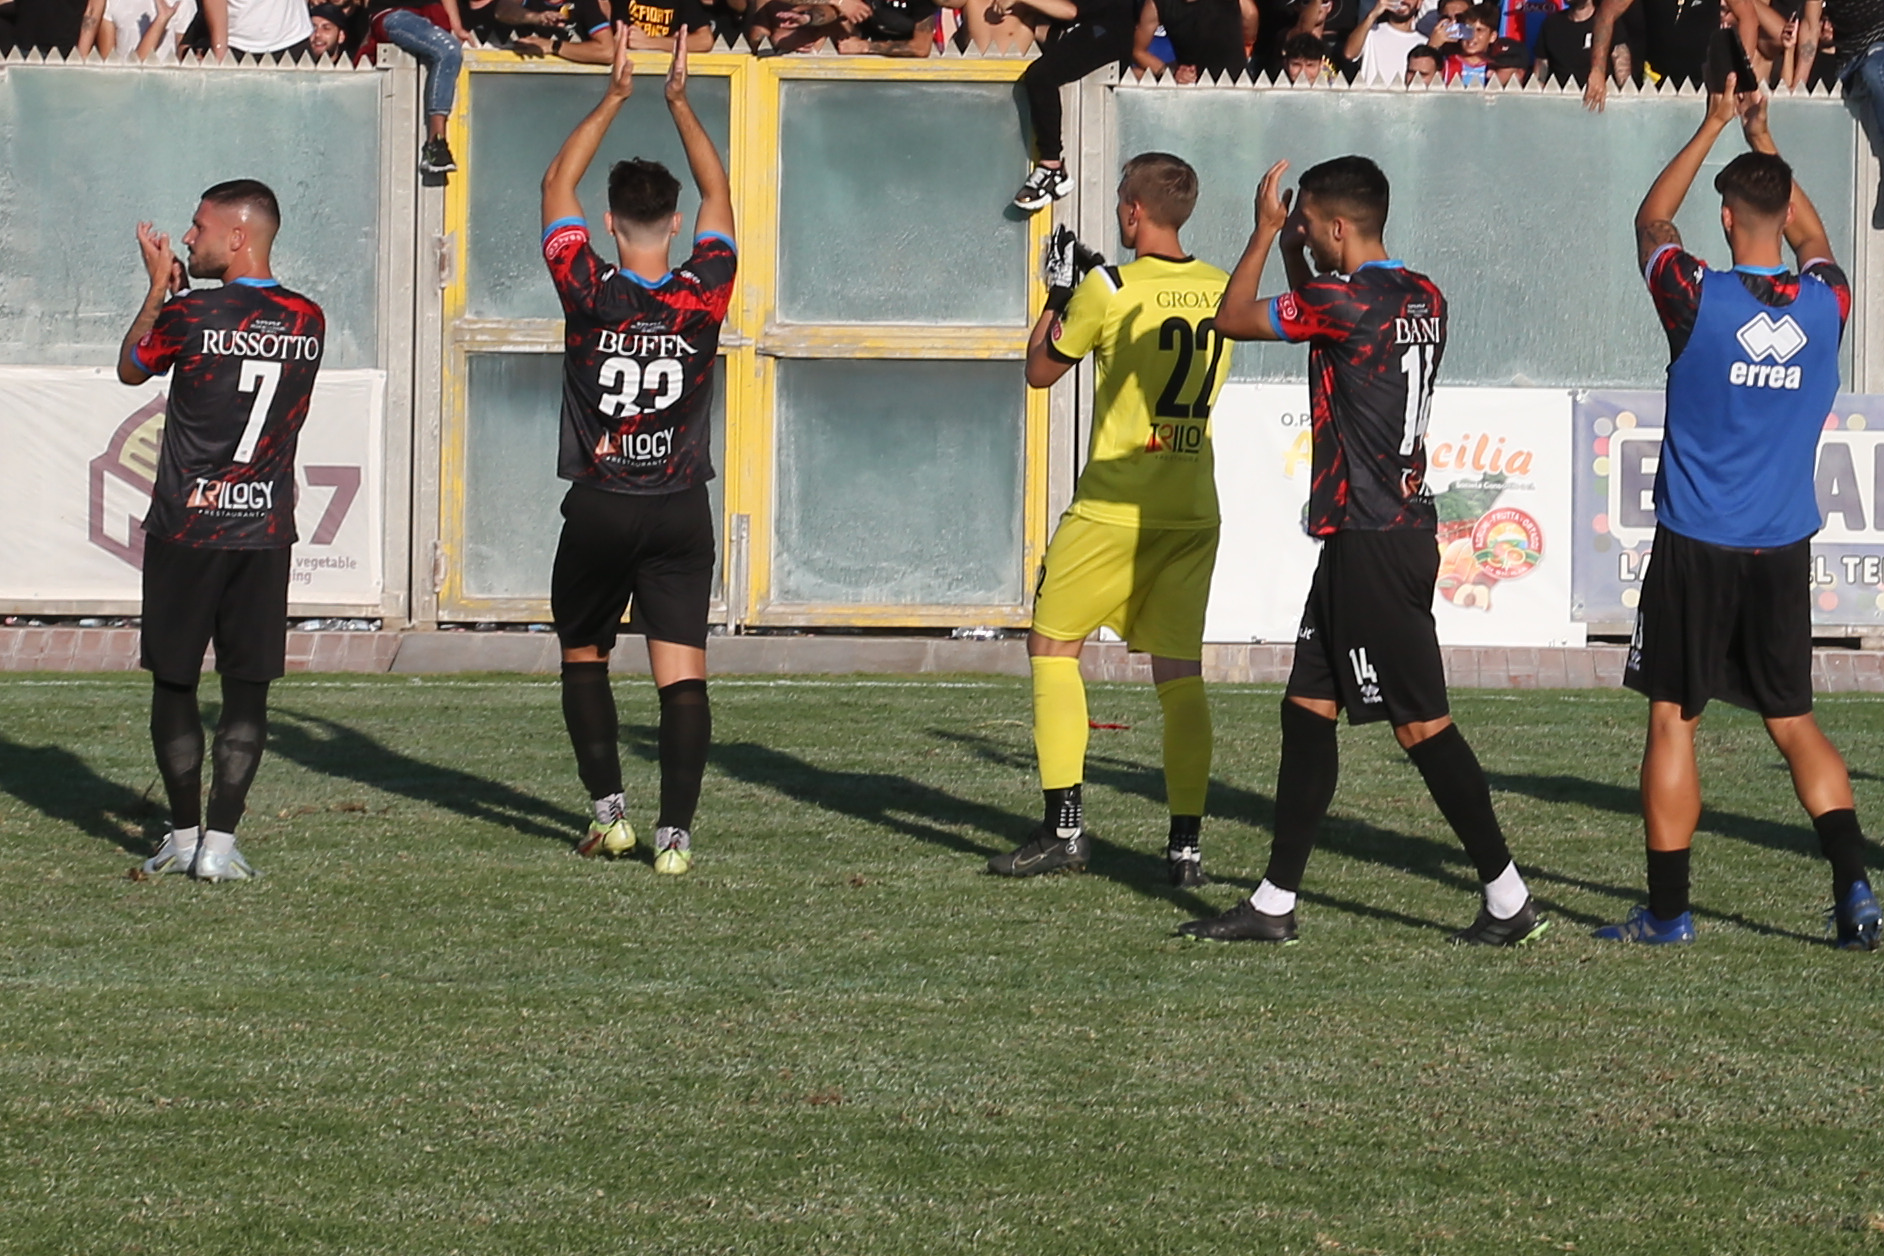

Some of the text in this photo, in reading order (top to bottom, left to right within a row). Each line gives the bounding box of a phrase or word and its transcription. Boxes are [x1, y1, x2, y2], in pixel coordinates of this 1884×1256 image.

[201, 329, 320, 361] RUSSOTTO
[597, 330, 698, 357] BUFFA
[1156, 316, 1224, 418] 22
[1729, 362, 1802, 389] errea
[232, 359, 283, 464] 7
[1145, 423, 1201, 454] TRILO
[187, 477, 274, 509] TRILOGY
[296, 556, 357, 571] vegetable
[1349, 647, 1378, 685] 14
